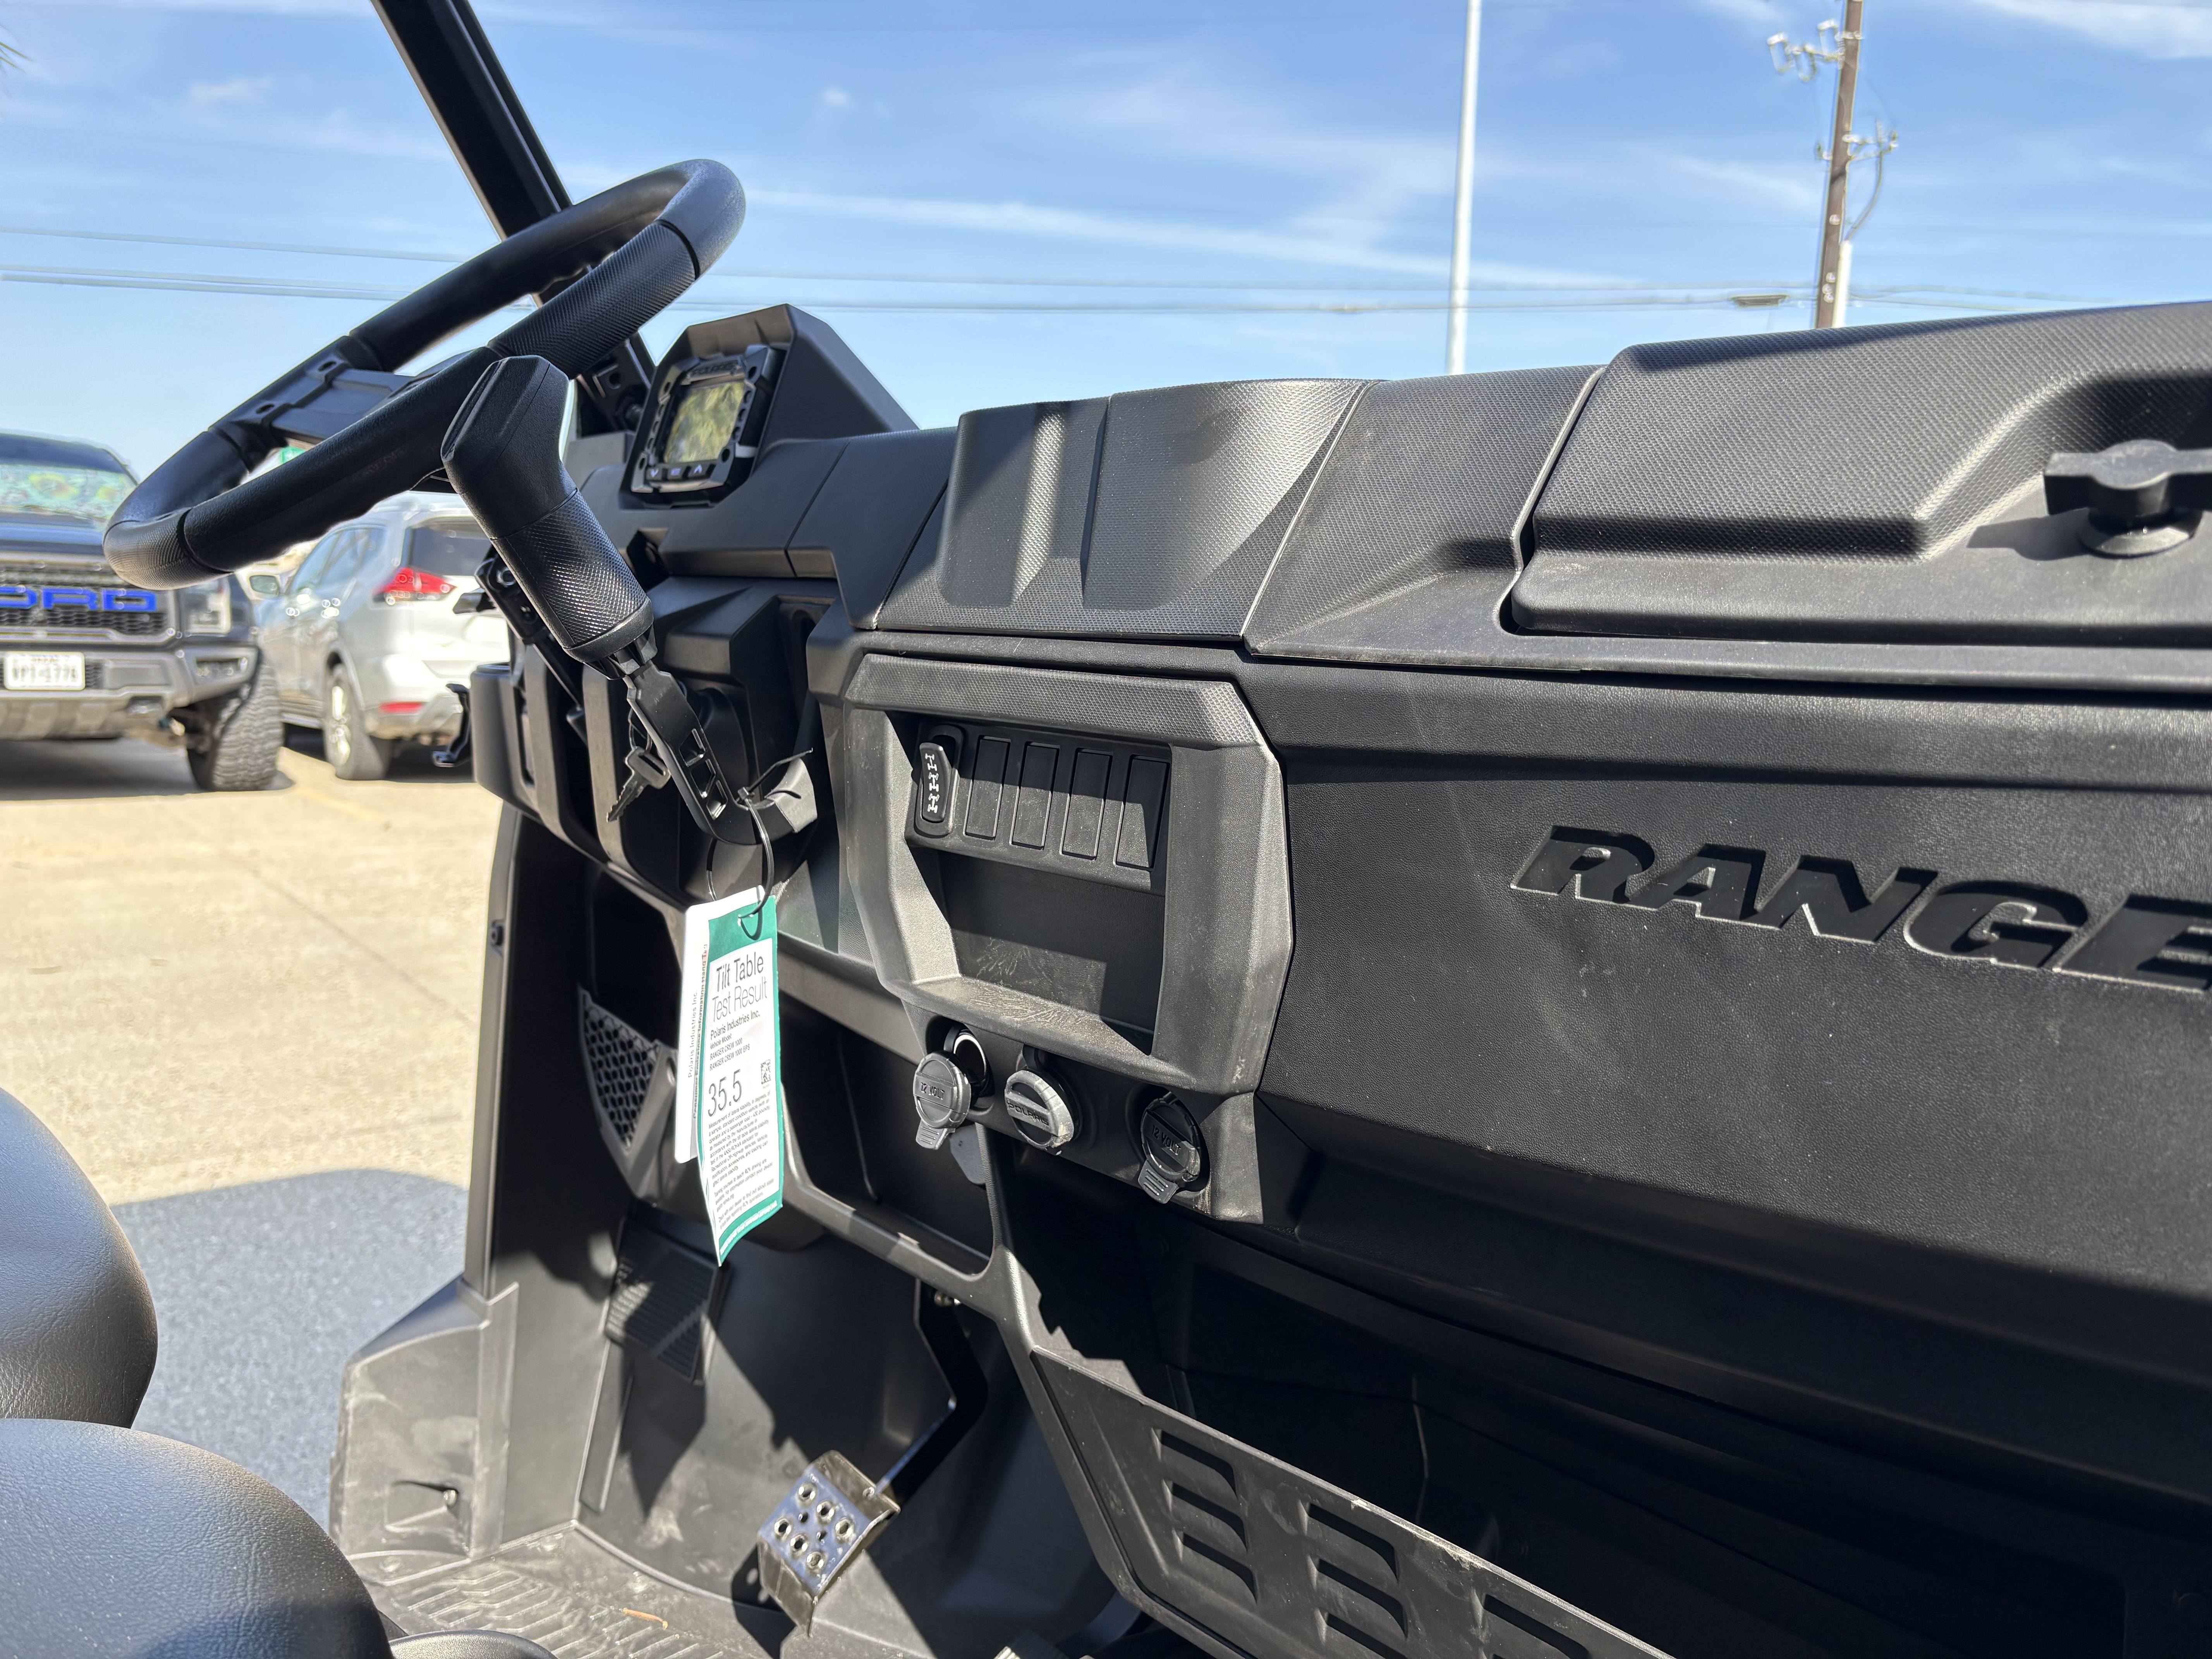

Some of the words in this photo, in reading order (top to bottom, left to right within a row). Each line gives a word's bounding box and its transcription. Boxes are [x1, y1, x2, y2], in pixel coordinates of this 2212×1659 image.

[716, 963, 730, 992] Tilt
[734, 951, 764, 983] Table
[712, 991, 731, 1022] Test
[734, 976, 767, 1012] Result
[711, 1024, 726, 1041] Polaris
[727, 1014, 749, 1031] Industries
[751, 1010, 761, 1020] Inc.
[708, 1069, 742, 1117] 35.5
[921, 1082, 927, 1093] 12
[928, 1084, 945, 1100] VOLT
[1007, 1101, 1049, 1126] POLARIS
[1152, 1125, 1159, 1139] 12
[1162, 1132, 1181, 1155] VOLT
